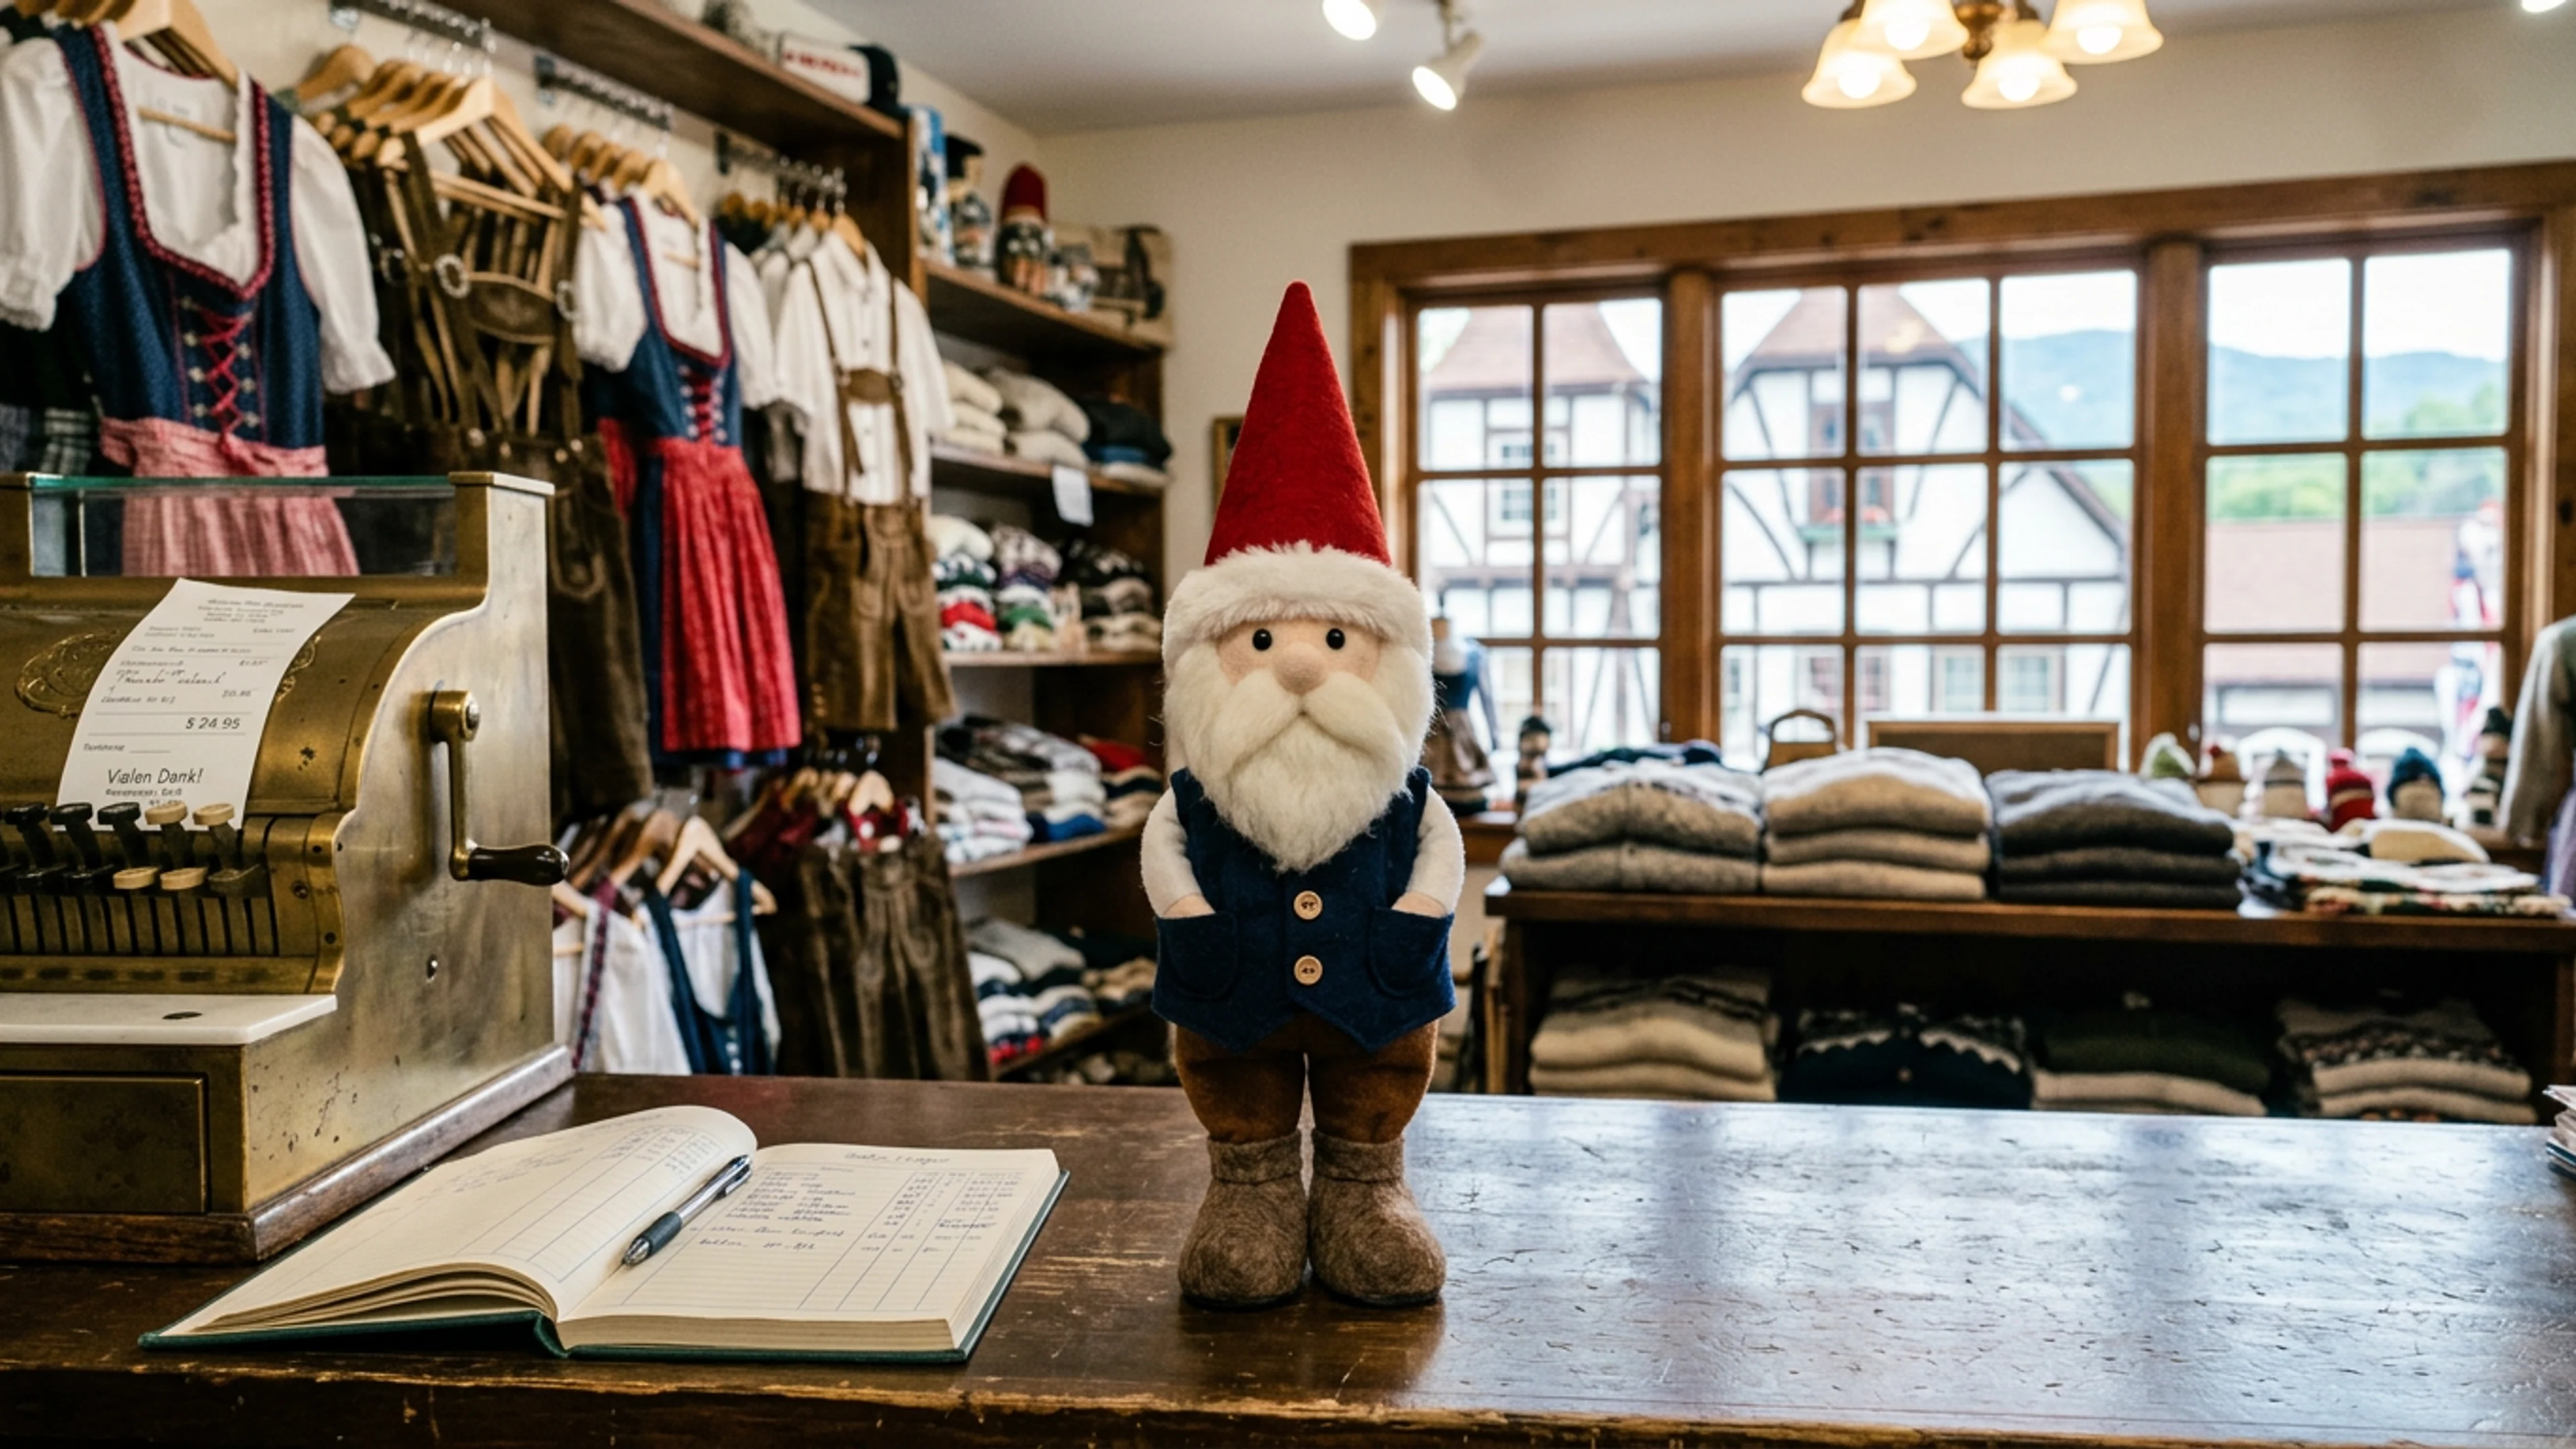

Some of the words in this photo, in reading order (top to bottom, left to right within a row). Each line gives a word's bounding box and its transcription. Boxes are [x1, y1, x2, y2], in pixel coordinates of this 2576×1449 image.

[186, 716, 195, 729] $
[199, 716, 241, 729] 24.95
[158, 767, 204, 784] Dank!
